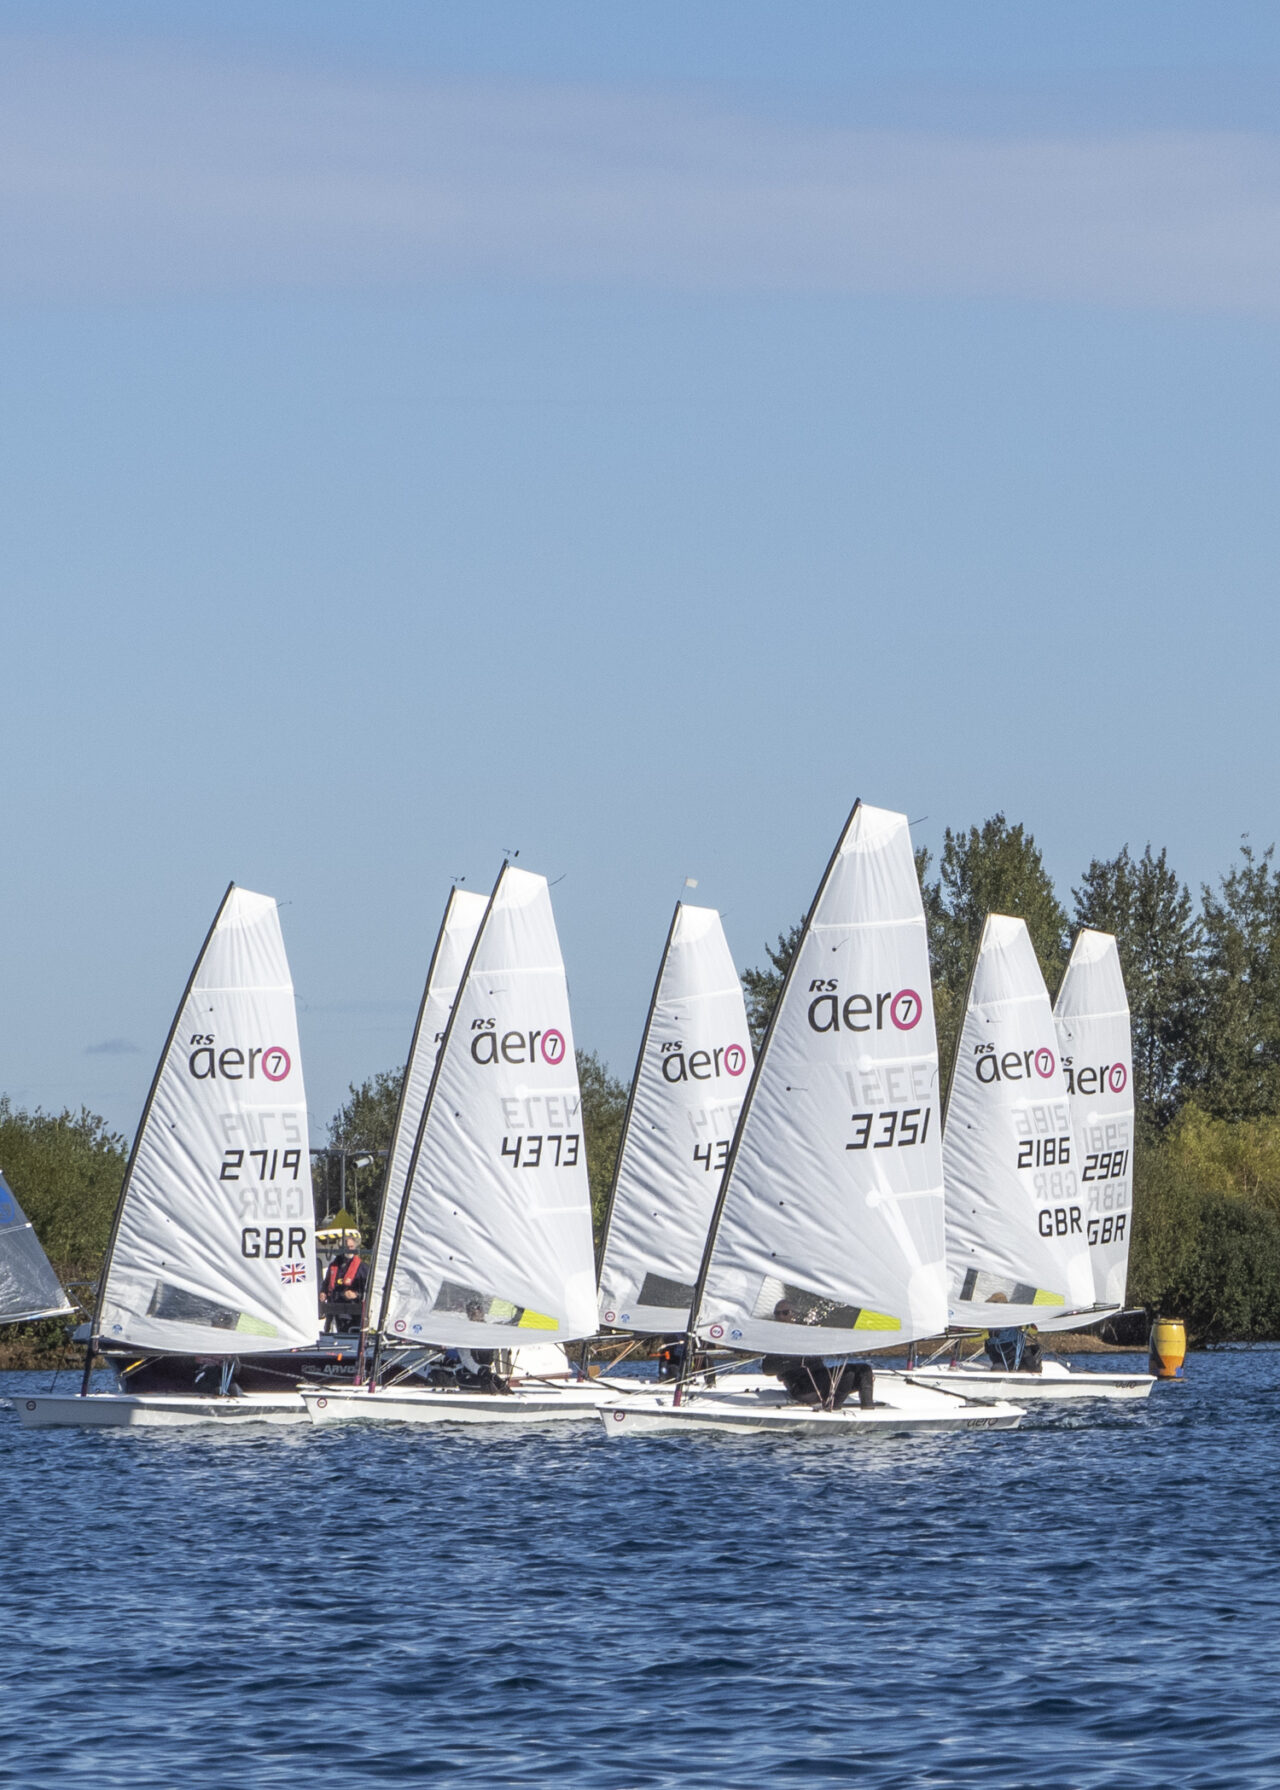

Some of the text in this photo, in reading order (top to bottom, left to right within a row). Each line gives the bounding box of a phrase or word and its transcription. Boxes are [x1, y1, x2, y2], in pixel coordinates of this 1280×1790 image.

[808, 979, 839, 992] RS
[471, 1018, 496, 1030] RS
[190, 1034, 215, 1046] RS
[660, 1041, 683, 1053] RS
[974, 1043, 995, 1055] RS
[845, 1107, 931, 1150] 3351
[219, 1149, 301, 1181] 2719
[501, 1134, 579, 1168] 4373
[693, 1140, 730, 1171] 43
[1017, 1137, 1070, 1169] 2186
[1082, 1150, 1129, 1182] 2981
[1038, 1206, 1083, 1237] GBR
[1087, 1214, 1126, 1246] GBR
[241, 1227, 306, 1259] GBR
